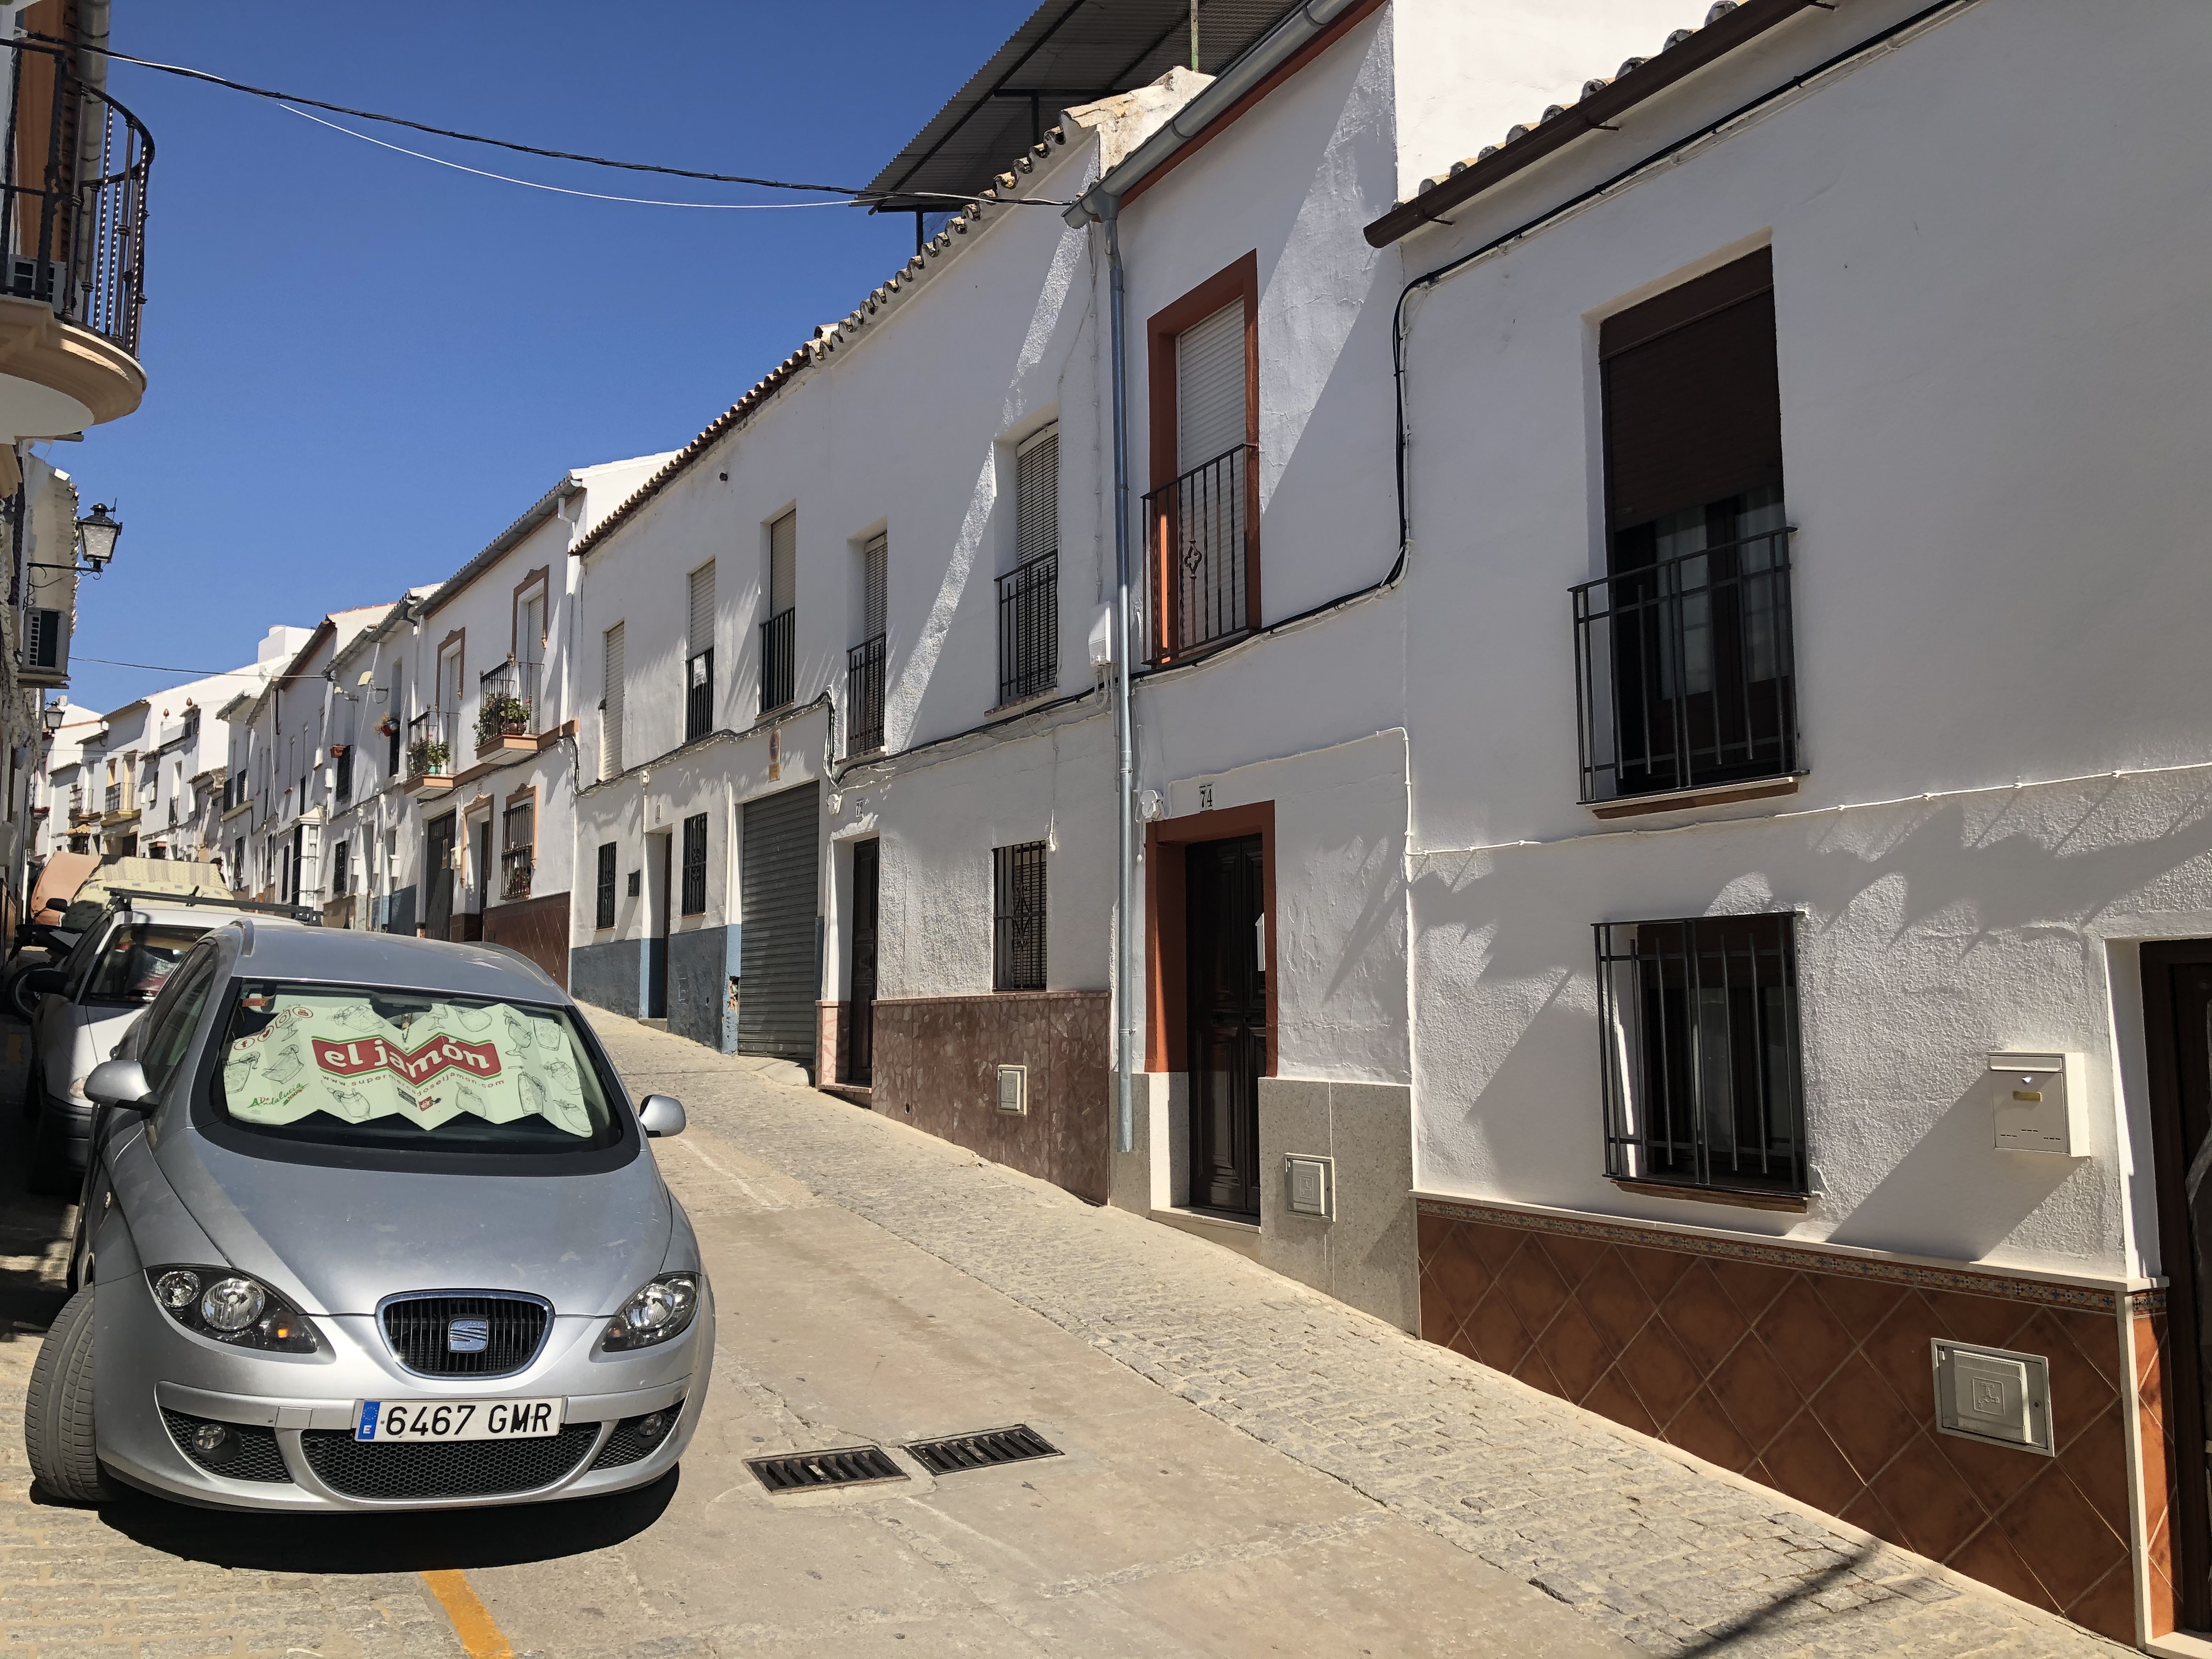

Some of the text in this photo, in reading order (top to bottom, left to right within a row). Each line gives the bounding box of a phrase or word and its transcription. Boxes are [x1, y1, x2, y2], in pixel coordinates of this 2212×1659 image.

[856, 801, 863, 816] 72
[1199, 788, 1212, 808] 74
[324, 1036, 489, 1078] el jamón
[322, 1071, 504, 1097] www.supermercadoseljamon.com
[362, 1425, 373, 1434] E
[385, 1403, 552, 1436] 6467 GMR
